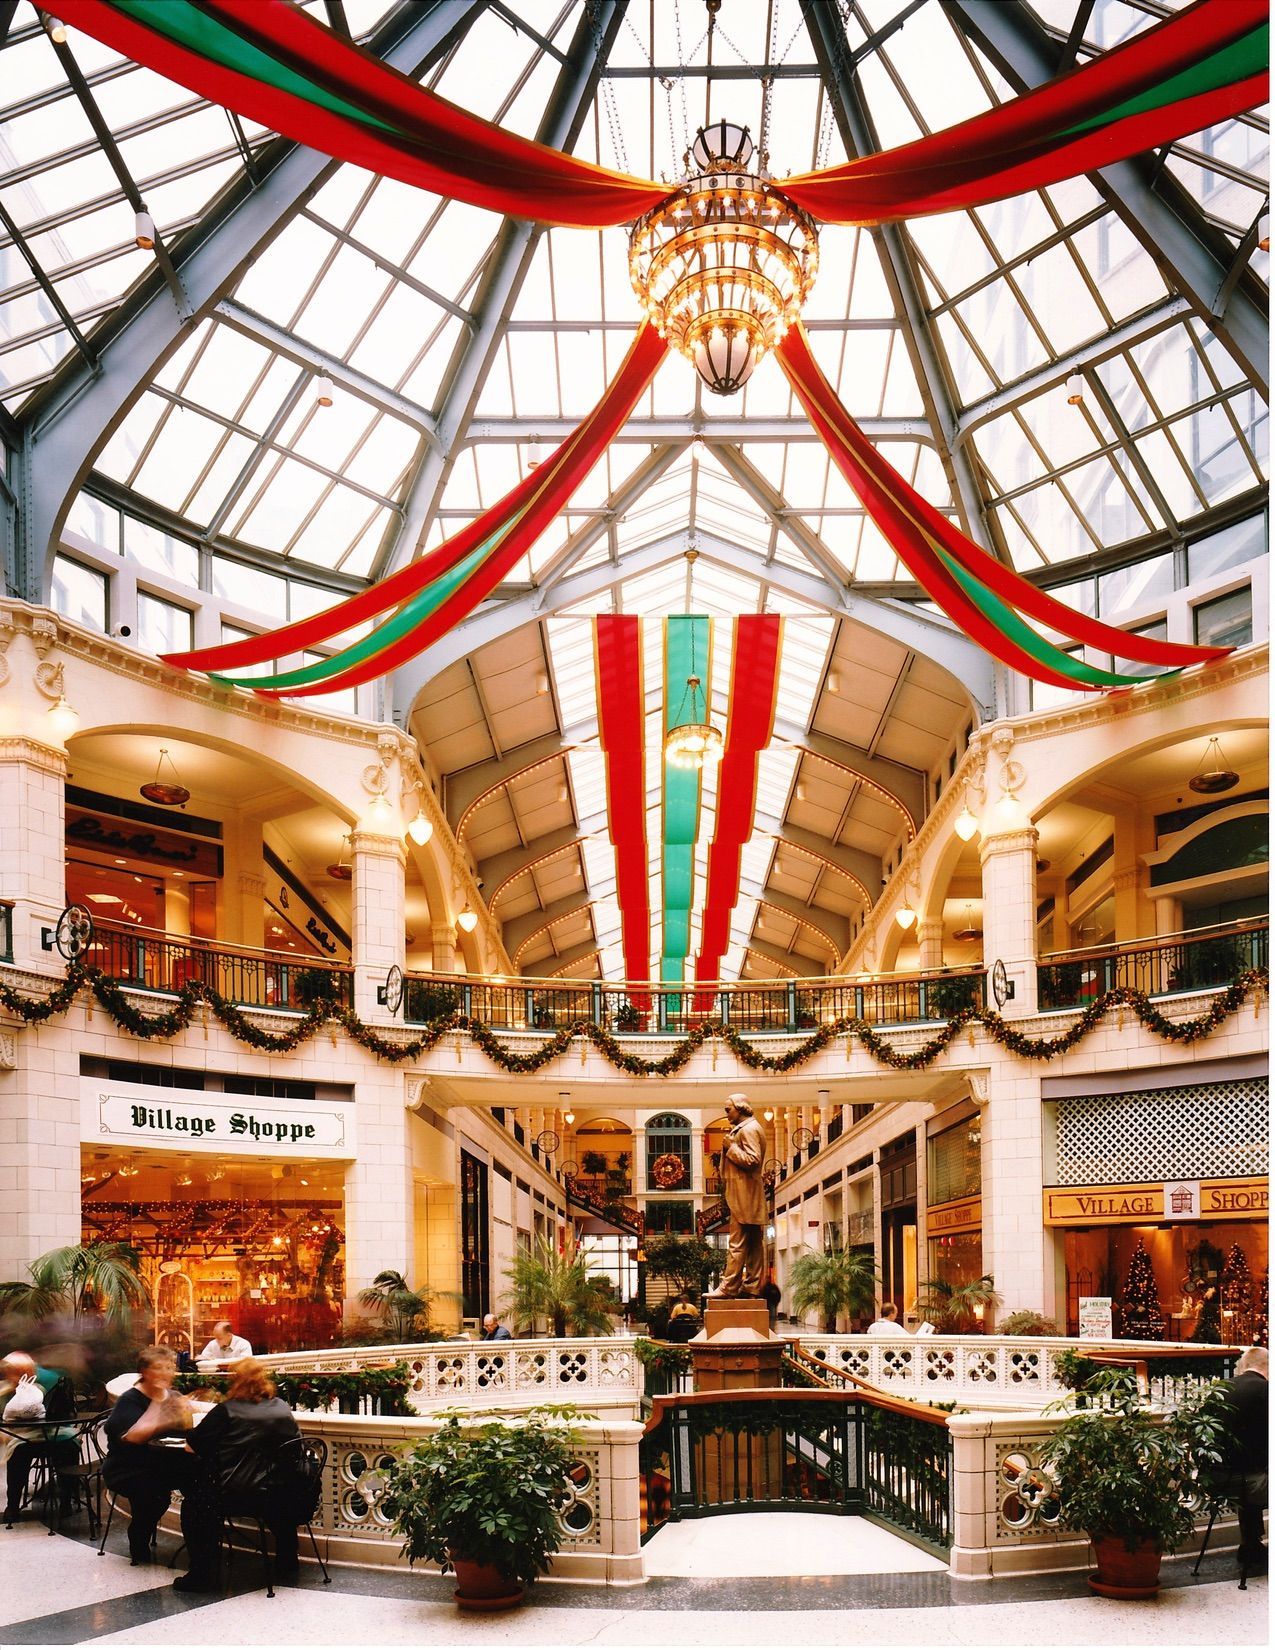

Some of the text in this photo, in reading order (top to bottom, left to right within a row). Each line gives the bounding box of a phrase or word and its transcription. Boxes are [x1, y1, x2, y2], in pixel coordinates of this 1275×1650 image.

[131, 1105, 316, 1142] Village Shoppe
[1076, 1190, 1269, 1214] VILLAGE SHOPP
